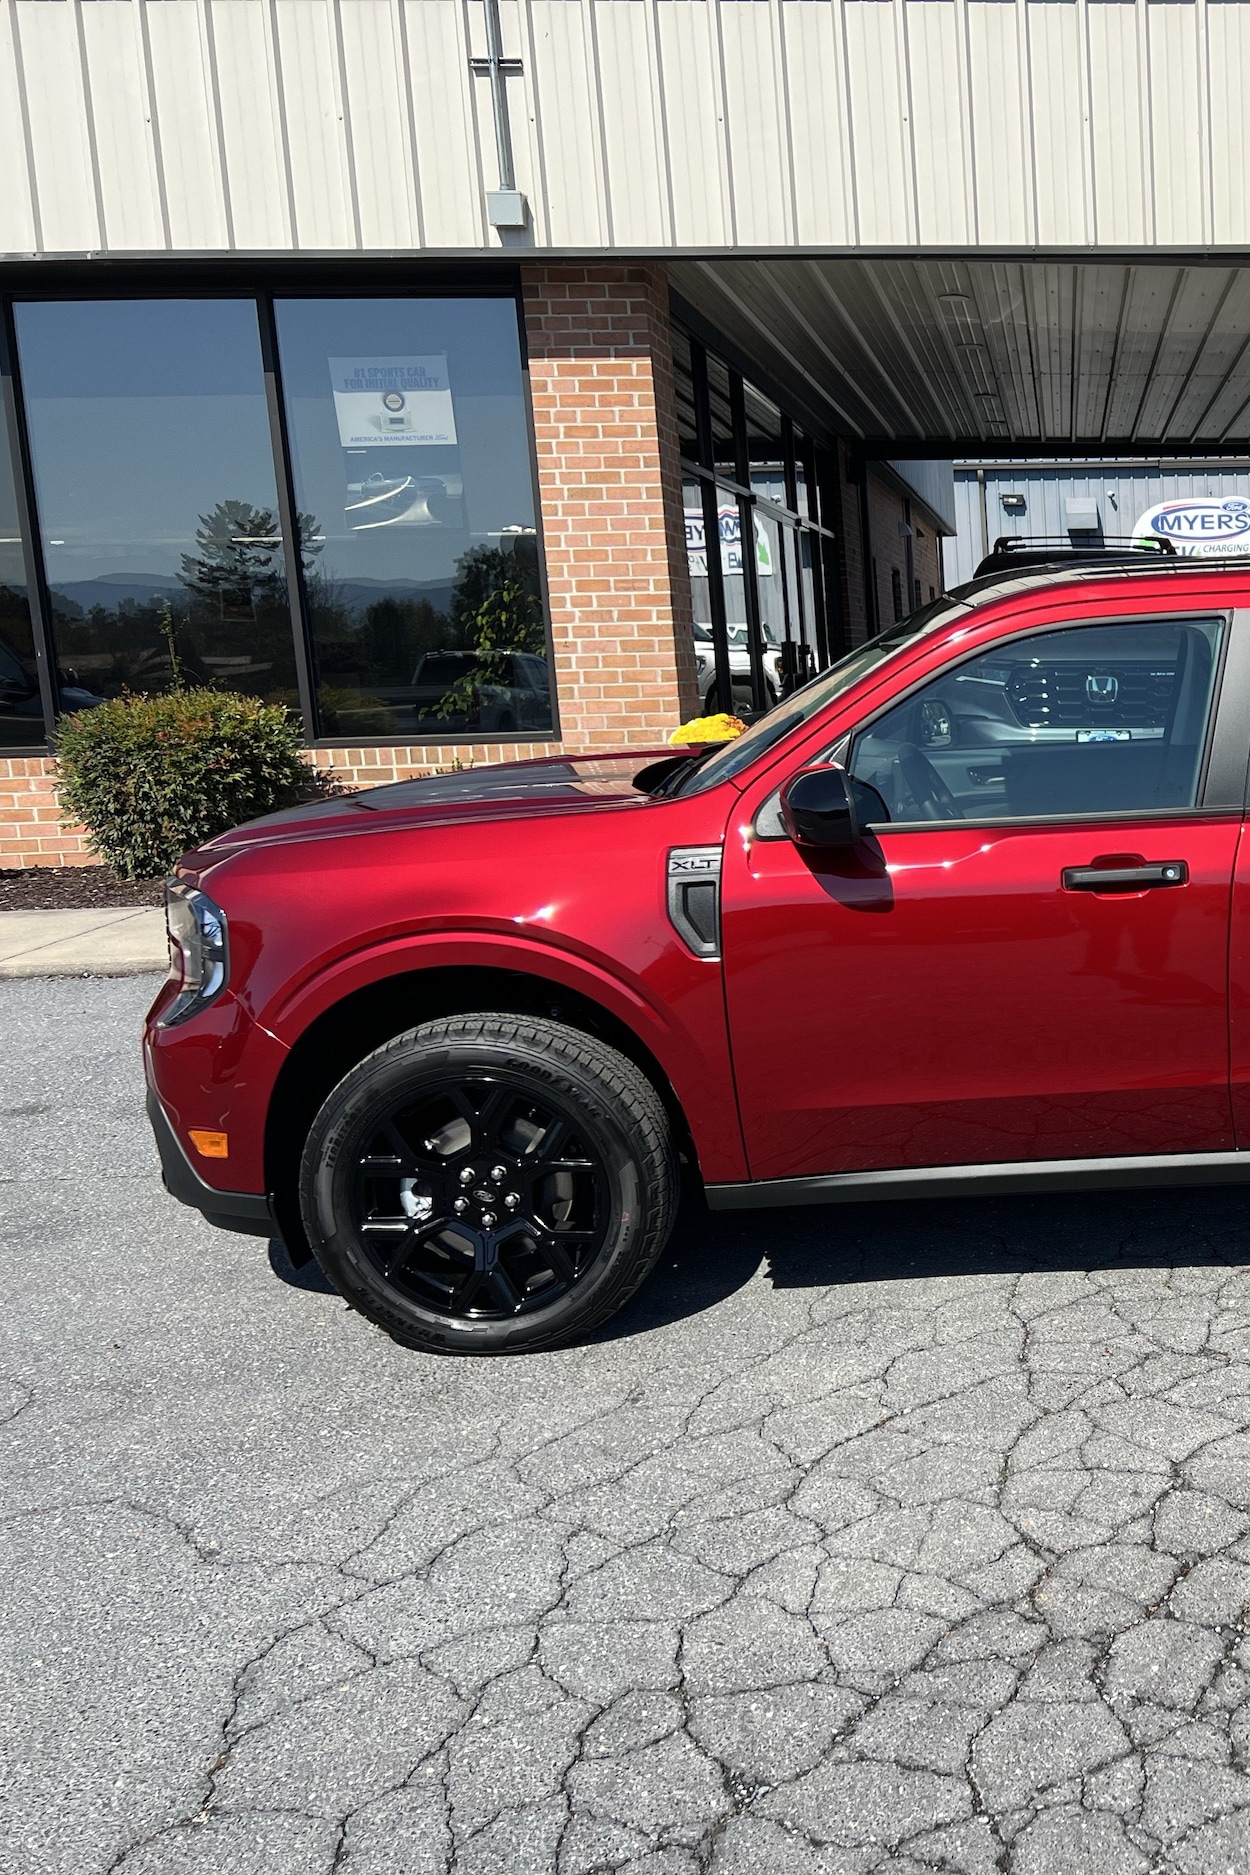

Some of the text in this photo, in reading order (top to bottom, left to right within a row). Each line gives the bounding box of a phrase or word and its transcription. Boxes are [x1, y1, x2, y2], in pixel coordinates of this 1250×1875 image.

[367, 366, 405, 379] SPORTS
[406, 366, 427, 378] CAR
[344, 377, 439, 390] FOR INITIAL QUALITY
[1160, 513, 1249, 531] MYERS
[1203, 543, 1249, 553] CHARGING
[671, 859, 720, 871] XLT
